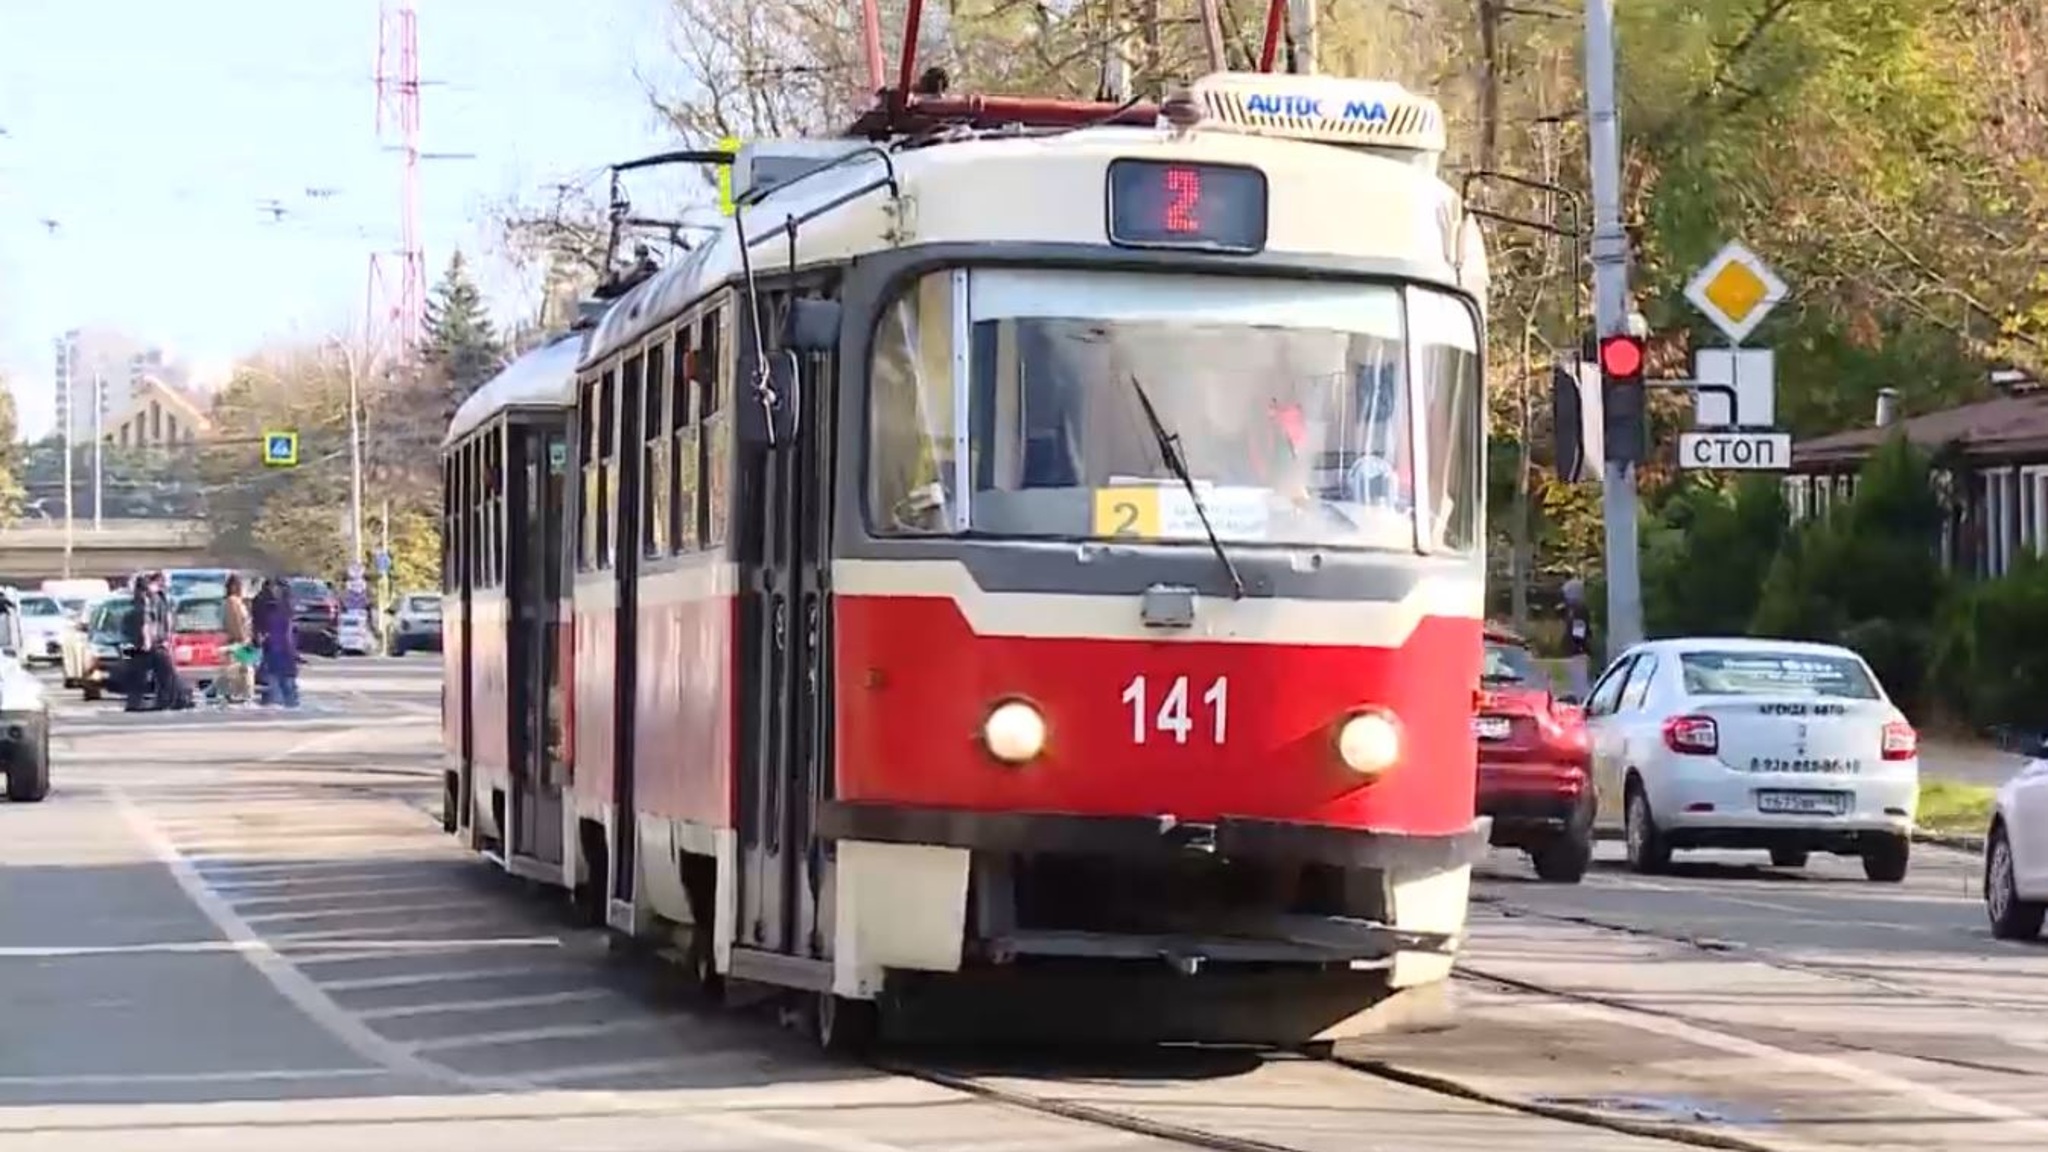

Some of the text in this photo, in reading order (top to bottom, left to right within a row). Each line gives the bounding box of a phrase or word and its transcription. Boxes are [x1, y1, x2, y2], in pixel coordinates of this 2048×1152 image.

[1166, 170, 1199, 231] 2
[1694, 439, 1774, 464] СТОП
[1113, 502, 1140, 537] 2
[1122, 675, 1228, 744] 141
